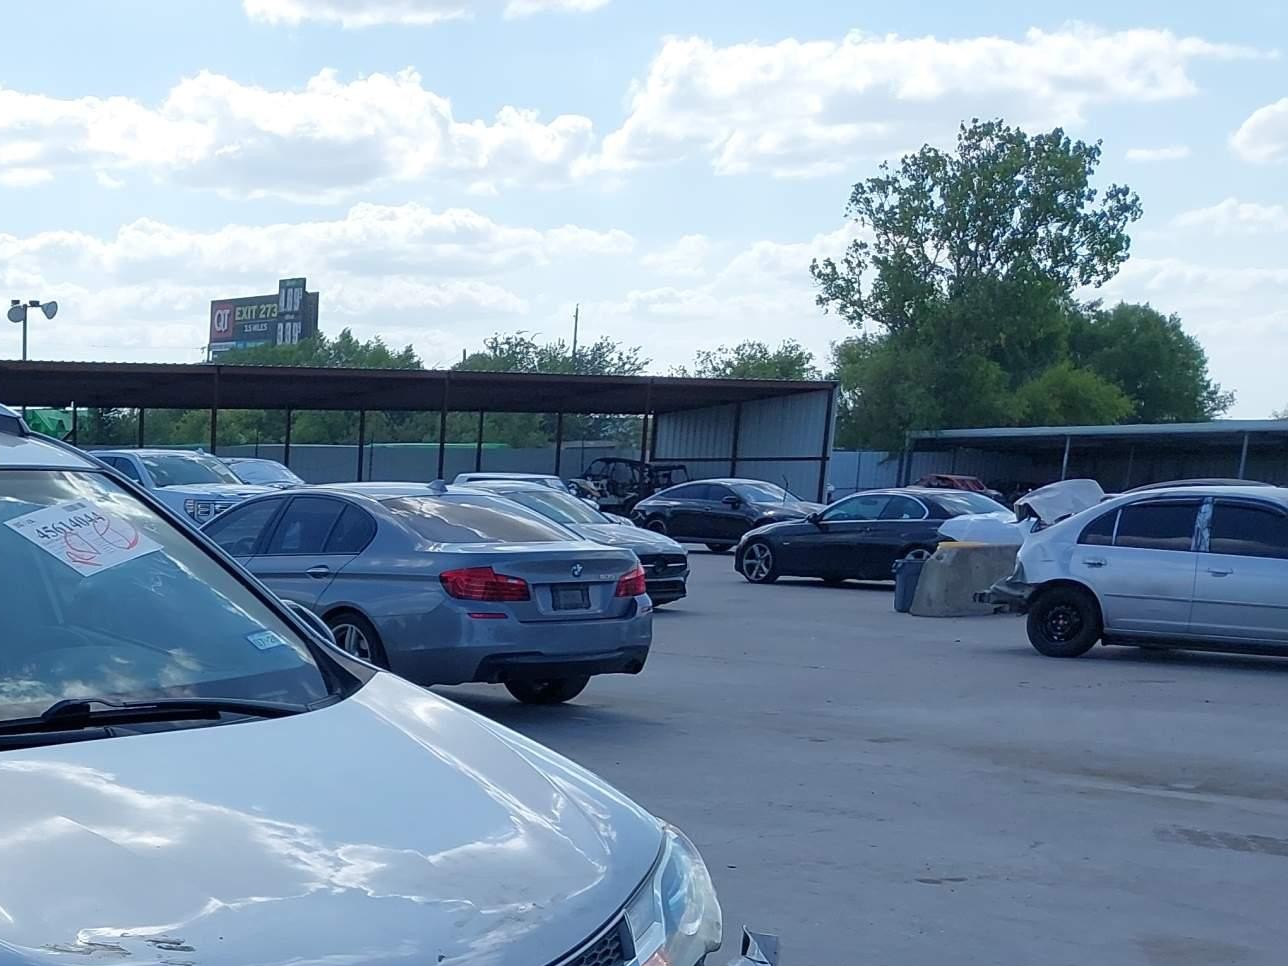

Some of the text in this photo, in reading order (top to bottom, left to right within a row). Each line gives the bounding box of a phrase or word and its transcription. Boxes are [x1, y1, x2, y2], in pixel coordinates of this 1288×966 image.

[214, 309, 230, 331] QT
[235, 303, 278, 320] EXIT 273
[36, 512, 105, 539] 45614044
